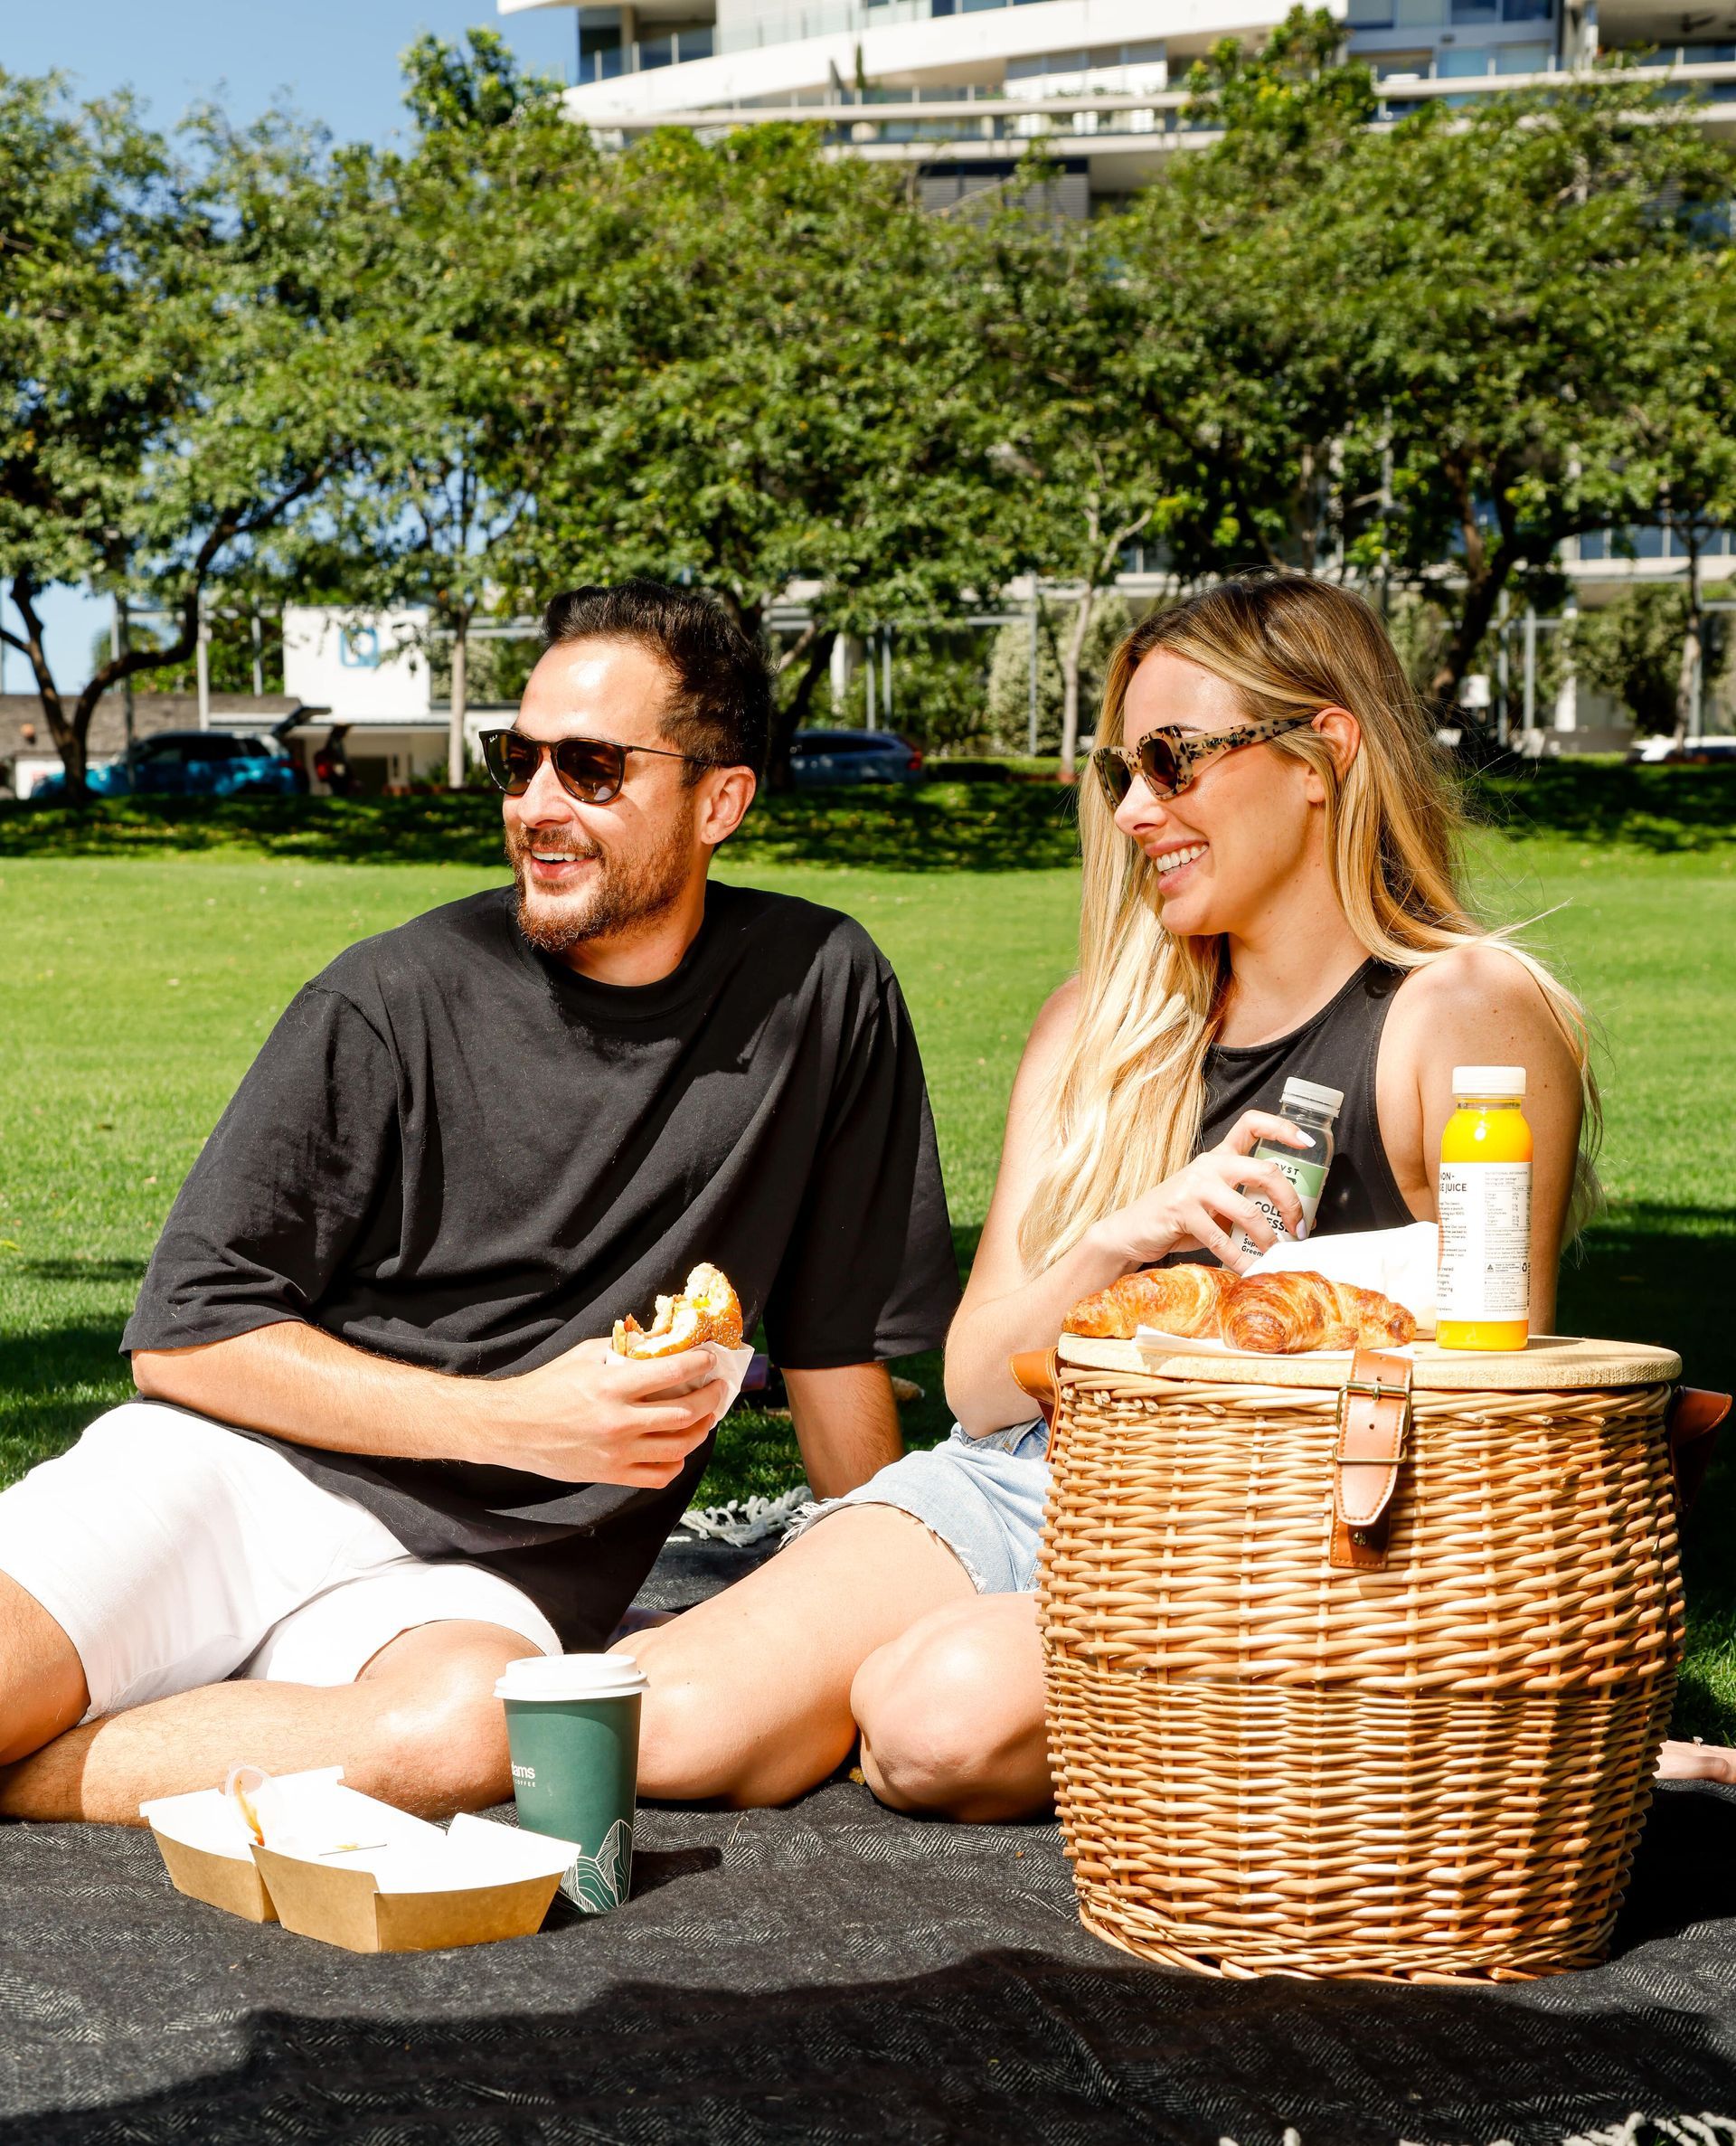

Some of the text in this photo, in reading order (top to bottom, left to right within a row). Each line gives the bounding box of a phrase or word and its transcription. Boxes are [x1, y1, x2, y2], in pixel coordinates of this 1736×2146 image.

[1275, 1162, 1299, 1176] VST
[1445, 1183, 1467, 1195] JUICE
[1243, 1237, 1259, 1248] Sup
